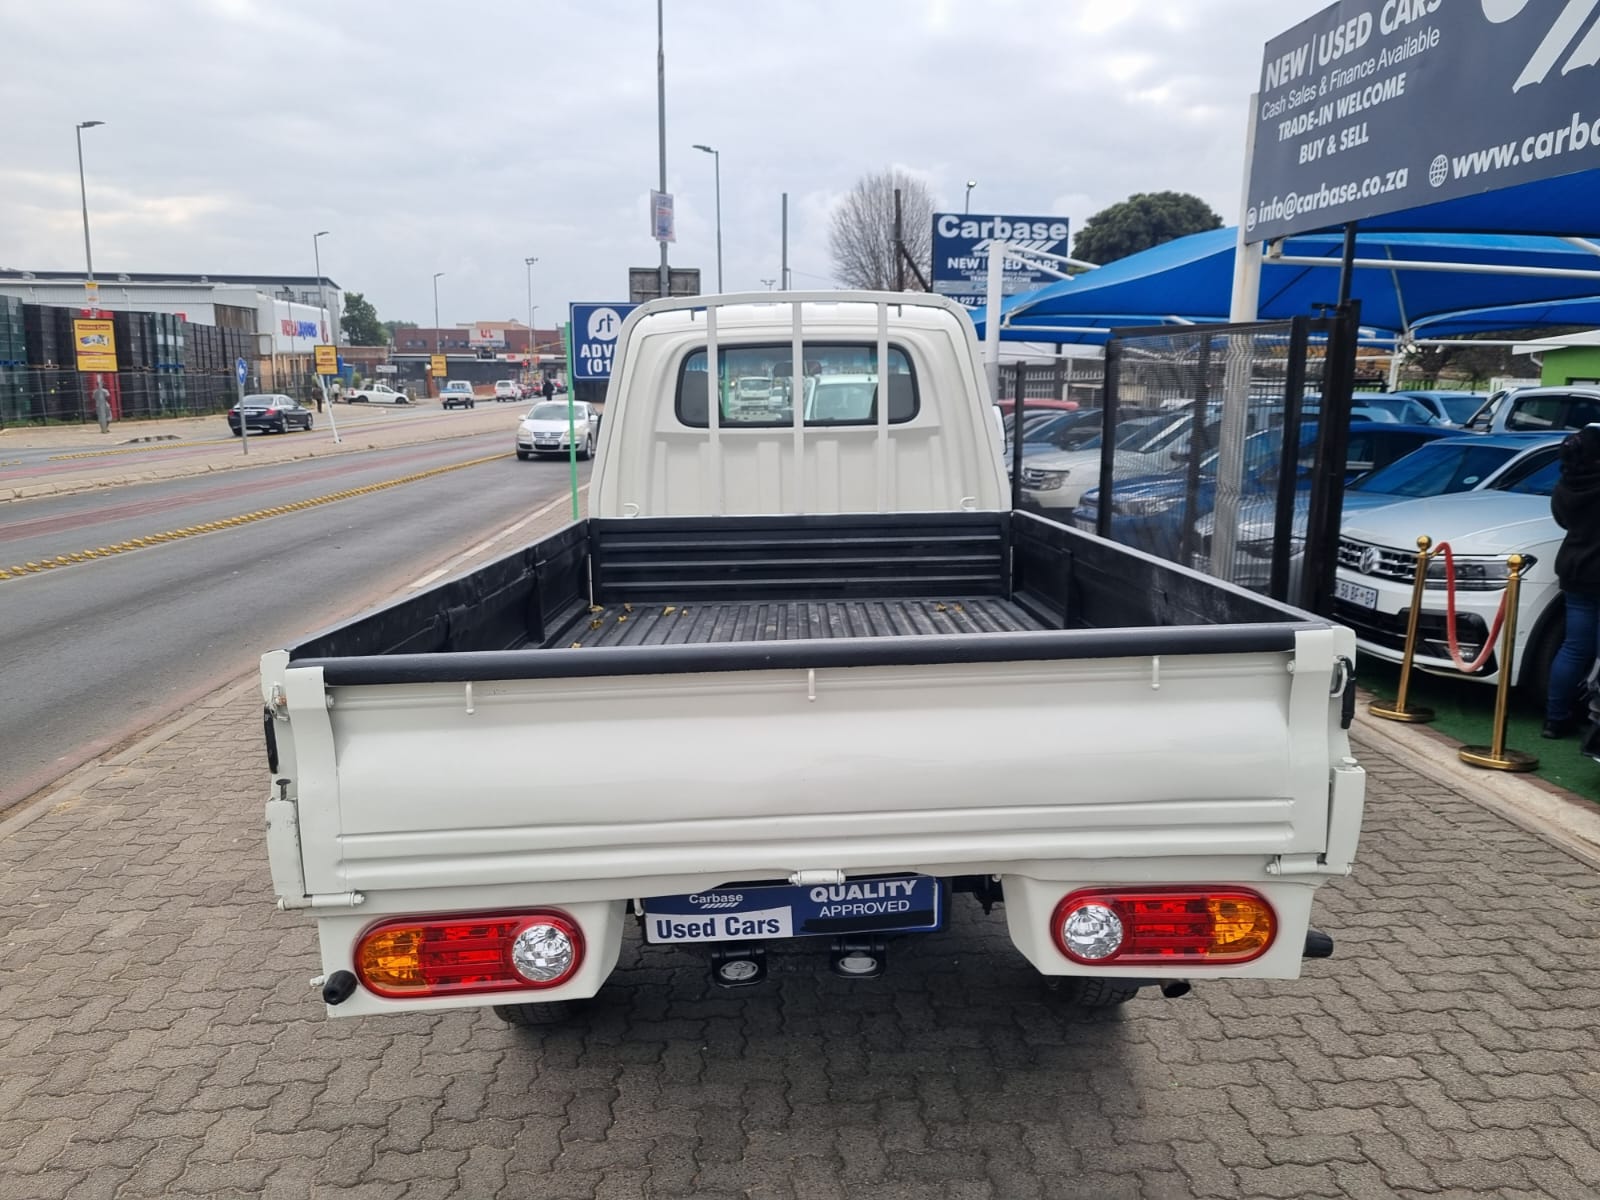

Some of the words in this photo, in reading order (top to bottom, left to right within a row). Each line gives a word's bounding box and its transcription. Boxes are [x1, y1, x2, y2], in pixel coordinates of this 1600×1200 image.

[1265, 44, 1310, 92] NEW
[1318, 11, 1373, 67] USED
[1261, 97, 1286, 121] Cash
[1288, 81, 1316, 110] Sales
[1319, 75, 1328, 97] &
[1329, 56, 1377, 93] Finance
[1377, 25, 1441, 70] Available
[1278, 104, 1334, 143] TRADE-IN
[1336, 73, 1407, 119] WELCOME
[1299, 140, 1326, 165] BUY
[1327, 135, 1337, 157] &
[1339, 122, 1369, 152] SELL
[1258, 167, 1409, 226] info@carbase.co.za
[937, 214, 1067, 240] Carbase
[947, 257, 980, 269] NEW
[976, 296, 987, 305] 22
[580, 344, 616, 358] ADV
[587, 358, 612, 376] (01
[689, 893, 744, 903] Carbase
[809, 879, 917, 904] QUALITY
[819, 900, 910, 917] APPROVED
[656, 917, 716, 939] Used
[724, 916, 780, 936] Cars
